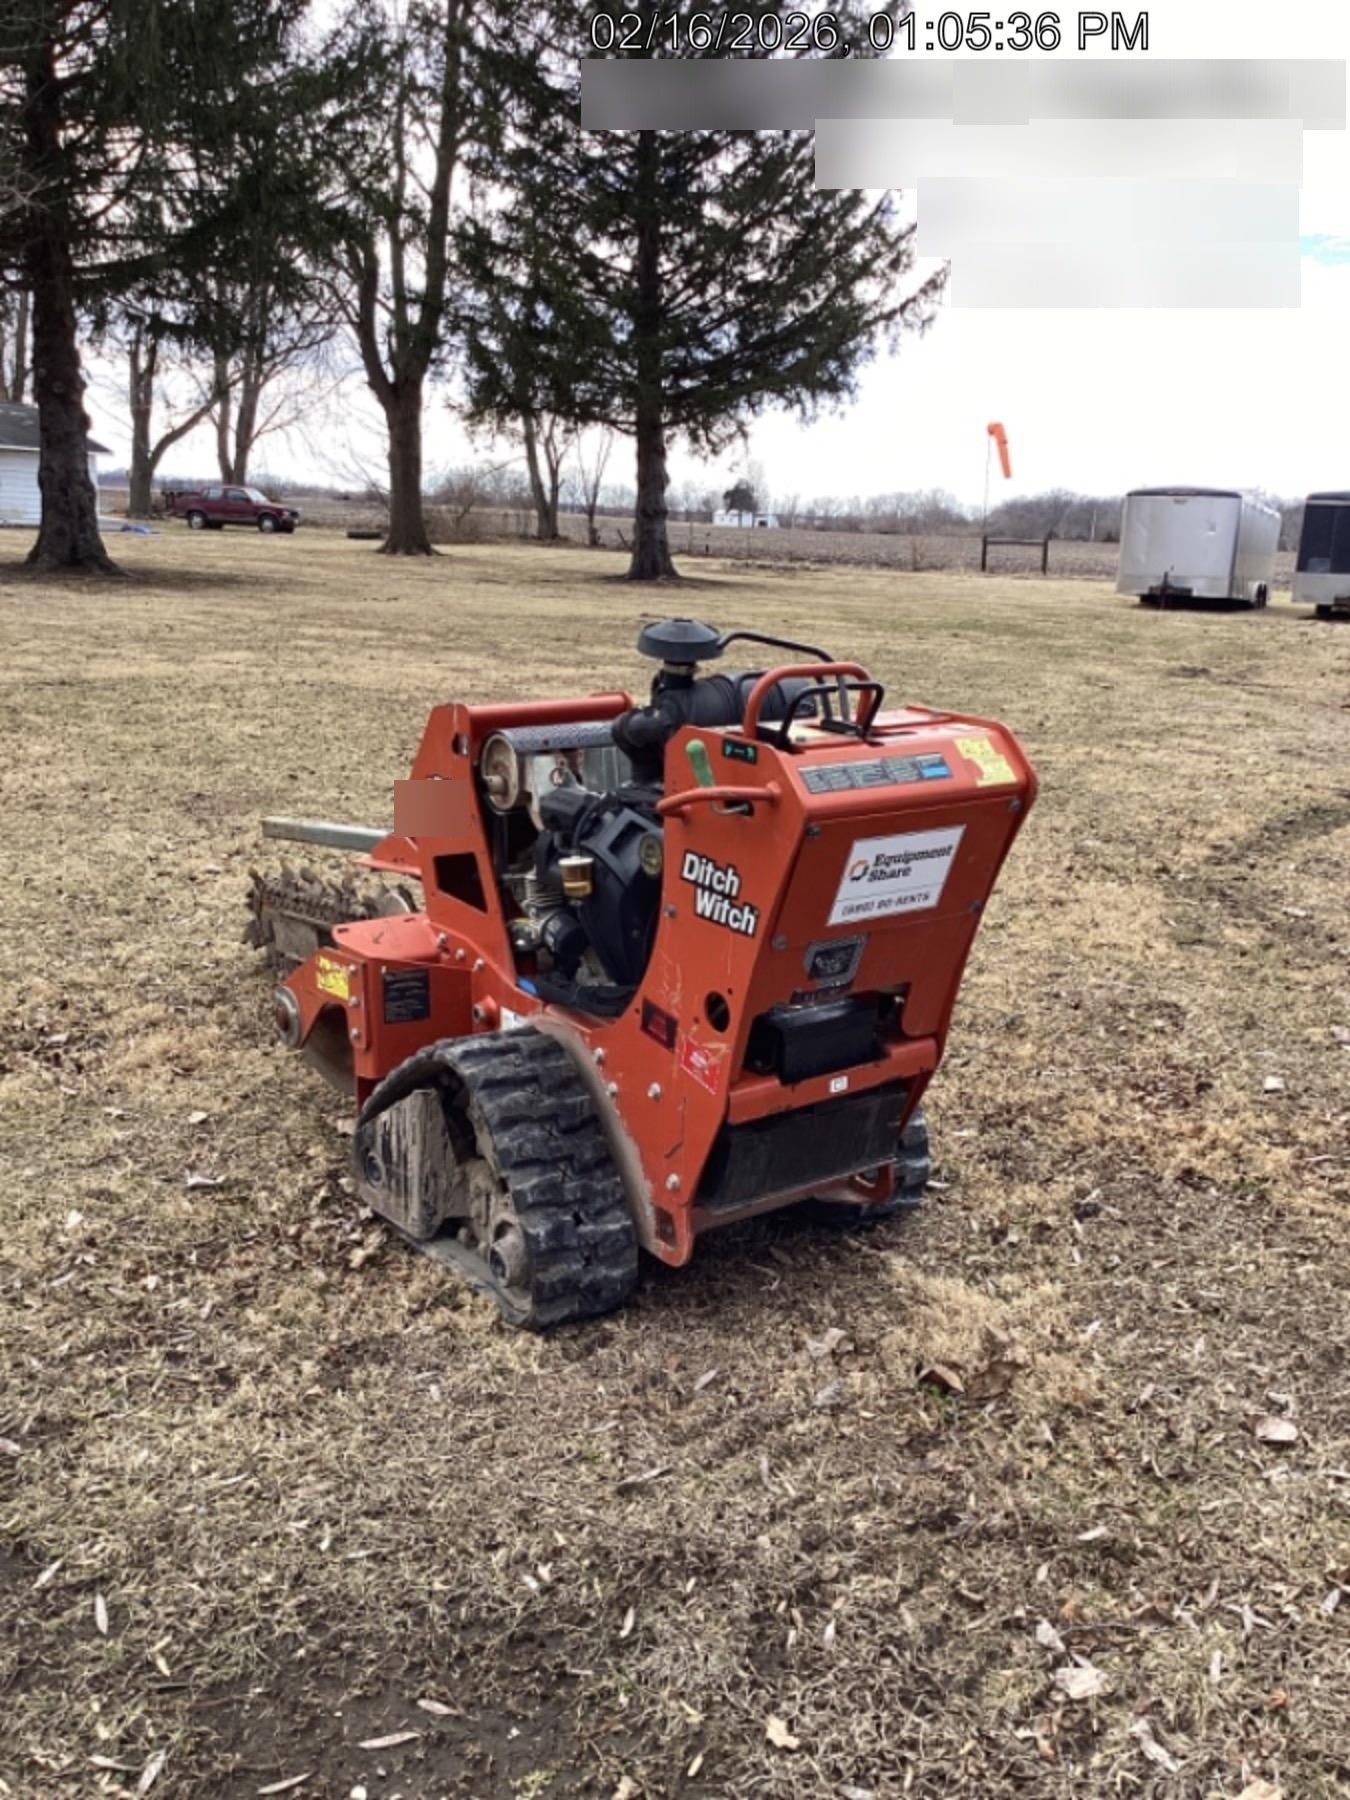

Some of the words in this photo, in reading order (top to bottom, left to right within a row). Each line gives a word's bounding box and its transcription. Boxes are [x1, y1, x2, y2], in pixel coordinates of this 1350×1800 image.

[873, 844, 953, 867] Equipment
[682, 851, 740, 897] Ditch
[867, 866, 912, 882] Share
[695, 887, 756, 936] Witch
